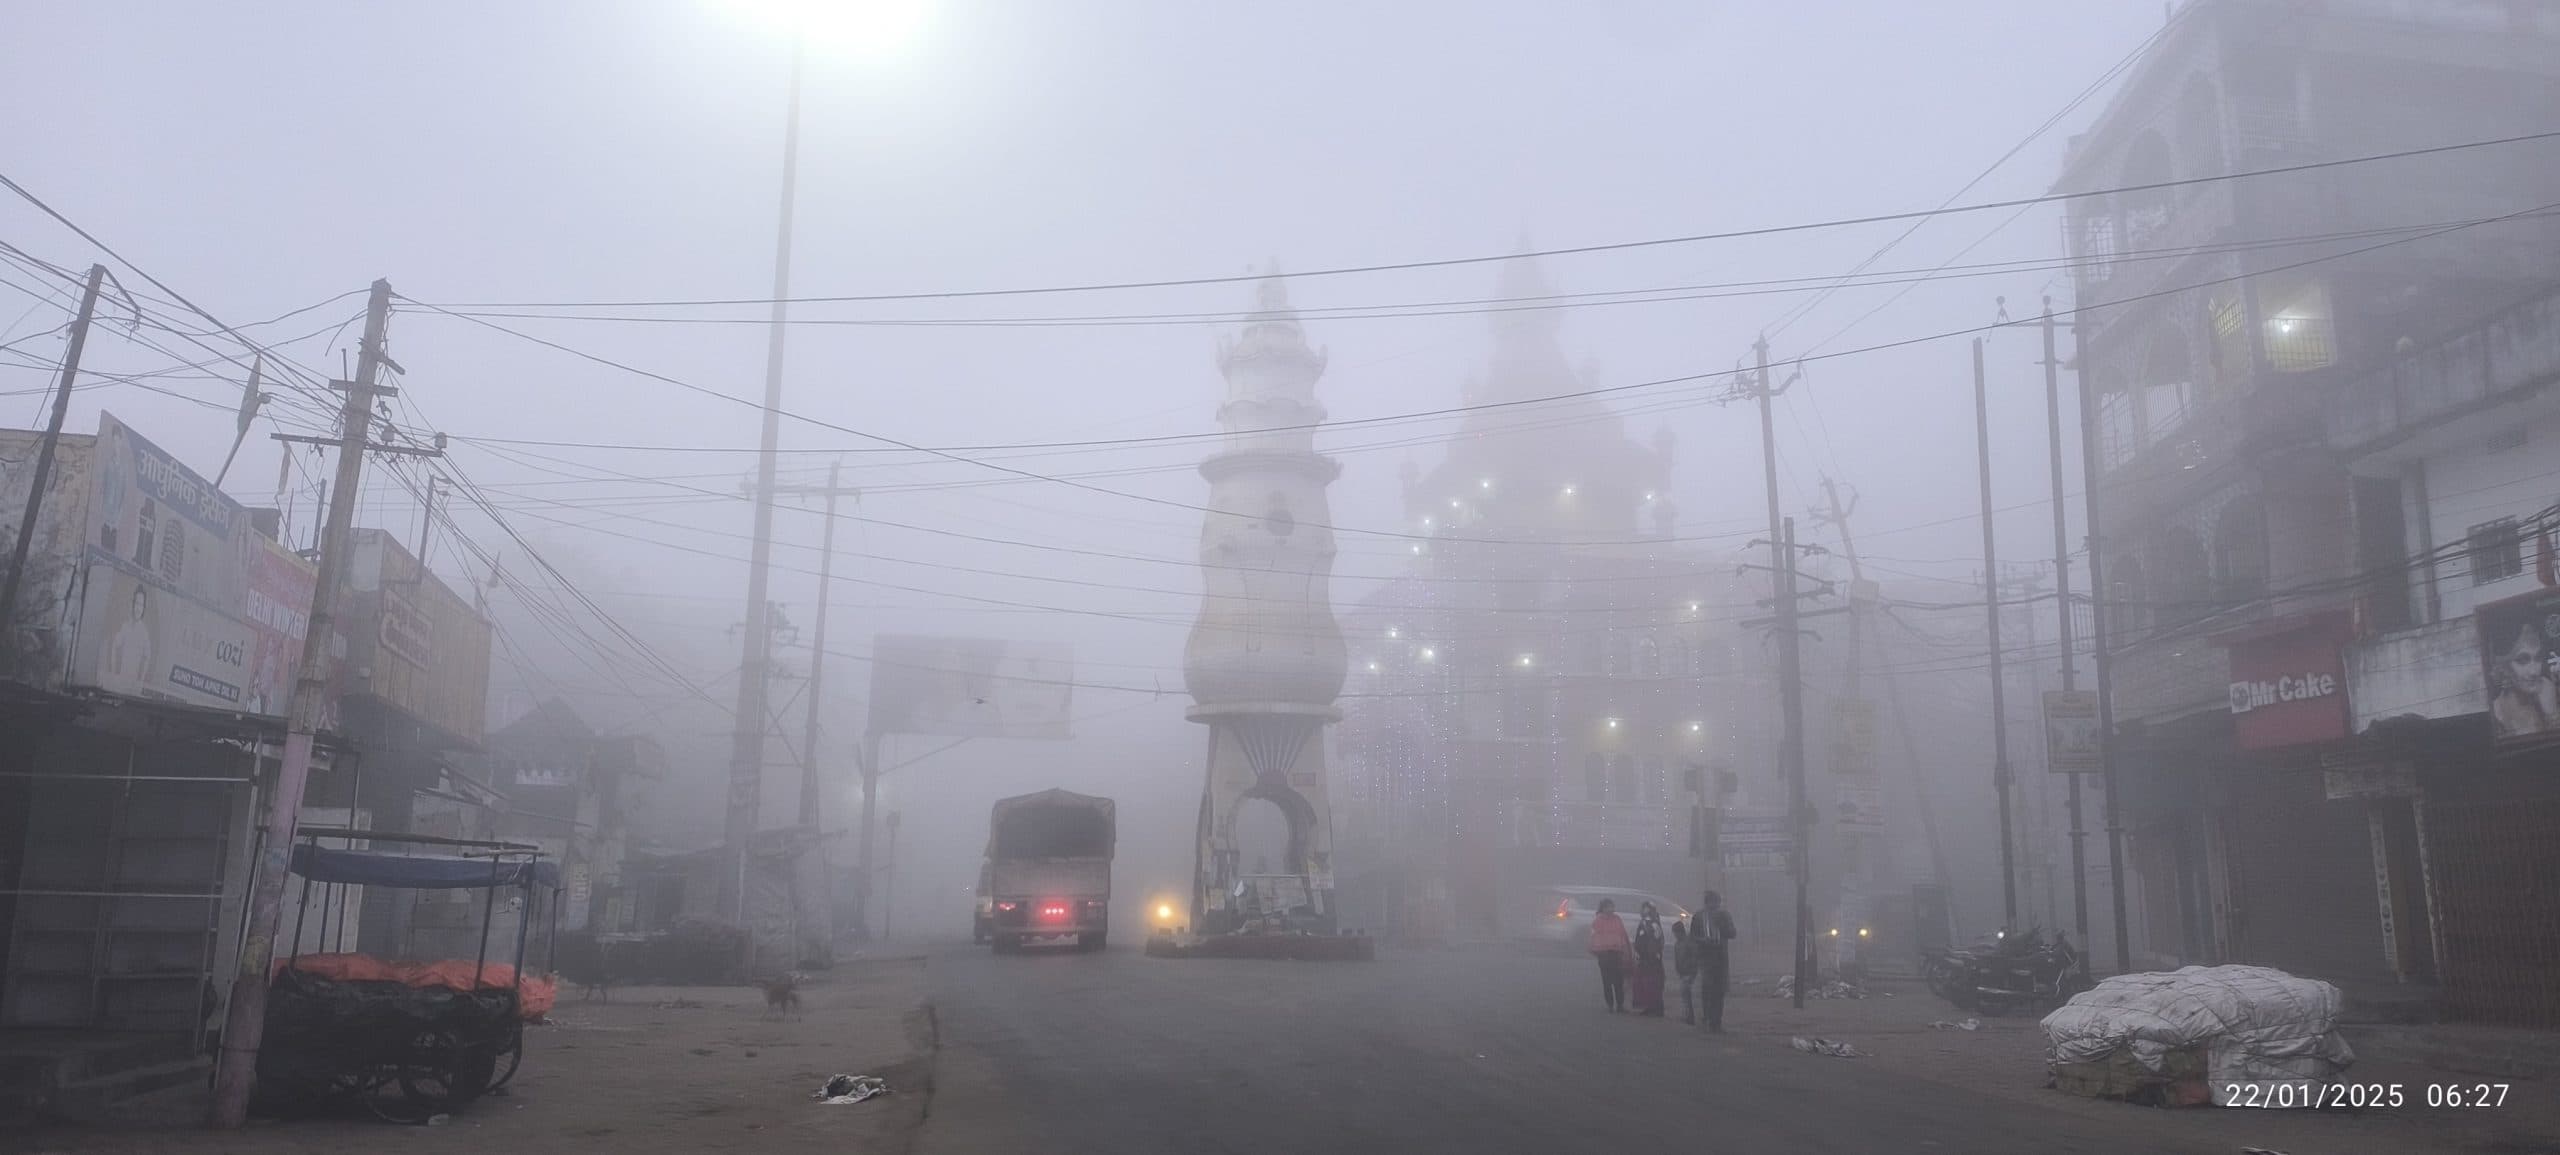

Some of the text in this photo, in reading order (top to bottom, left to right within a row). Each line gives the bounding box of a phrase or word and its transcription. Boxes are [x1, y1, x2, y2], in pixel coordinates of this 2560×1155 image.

[137, 448, 197, 504] आधुनिक
[247, 588, 273, 625] DELHI
[216, 640, 244, 667] cozi
[2250, 672, 2336, 706] Mr Cake
